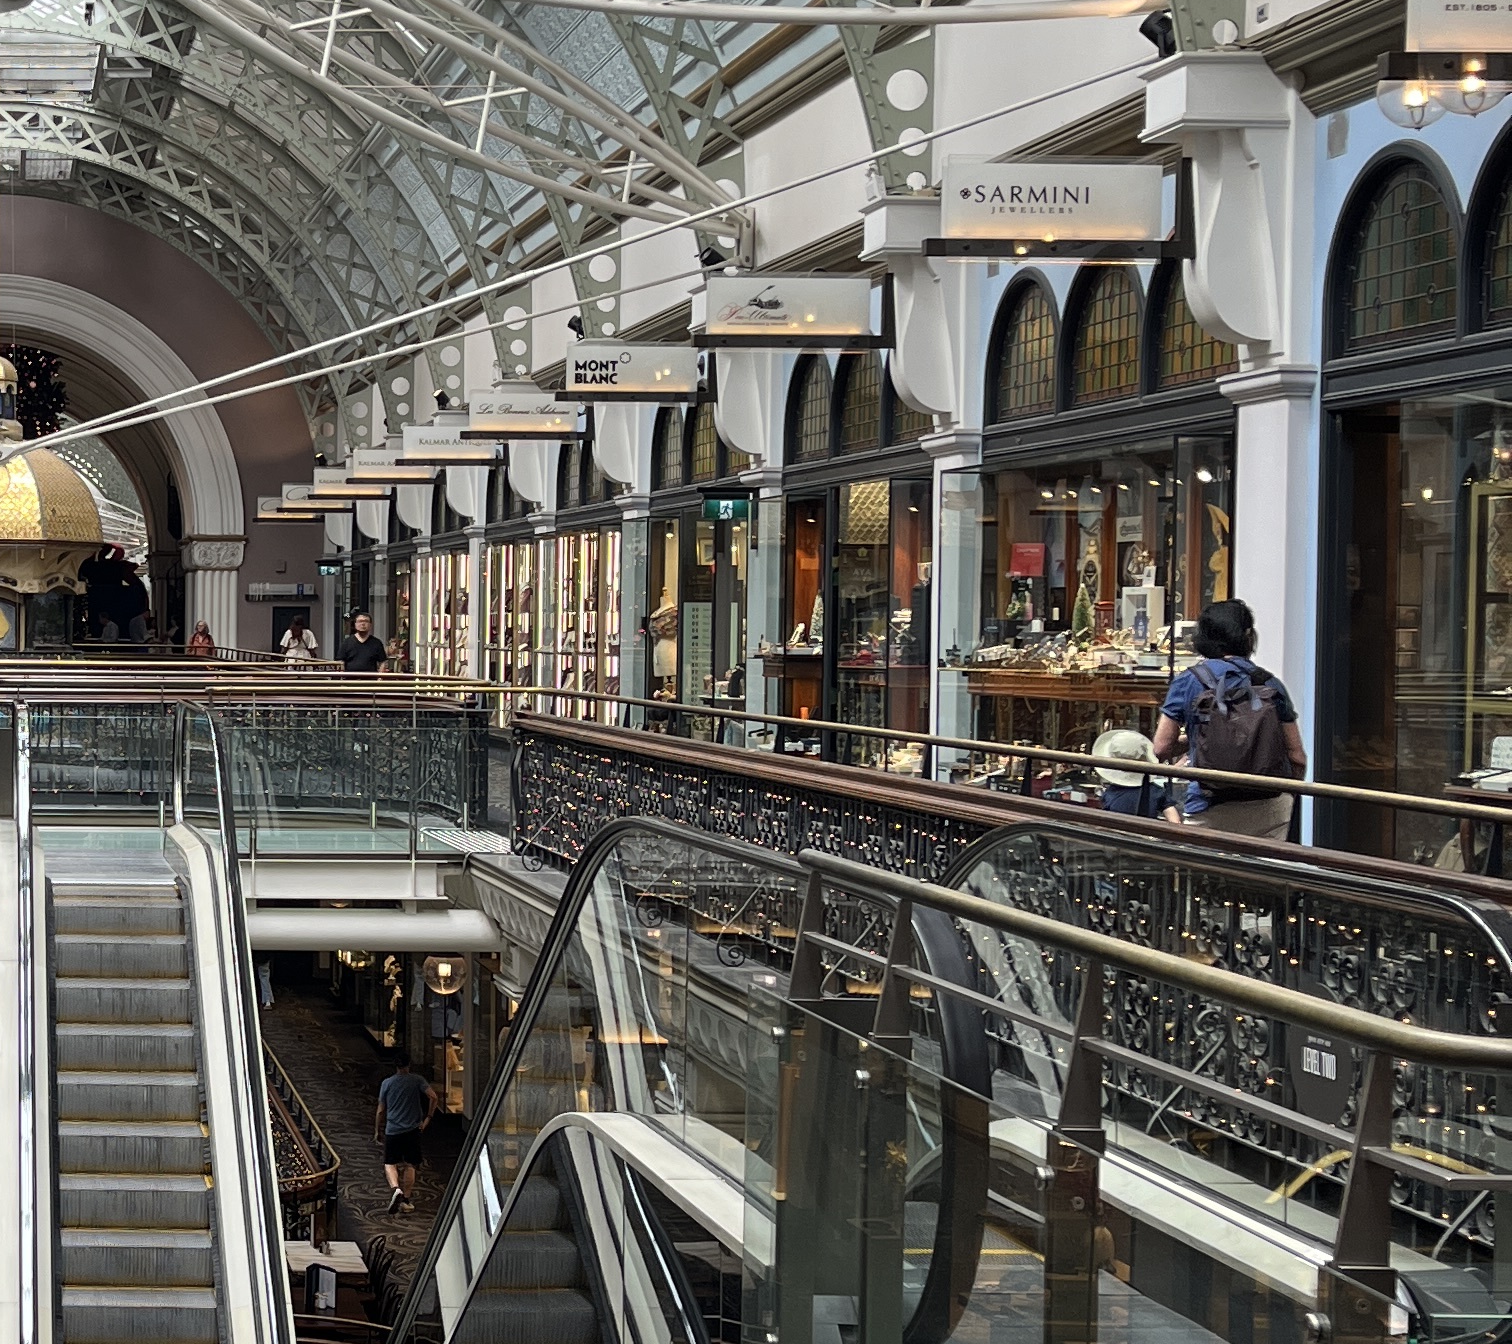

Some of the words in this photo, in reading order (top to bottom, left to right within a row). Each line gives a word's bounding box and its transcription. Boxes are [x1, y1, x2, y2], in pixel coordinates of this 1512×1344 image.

[974, 184, 1090, 204] SARMINI
[991, 206, 1074, 214] JEWELLERS
[574, 360, 619, 372] MONT
[574, 373, 618, 384] BLANC
